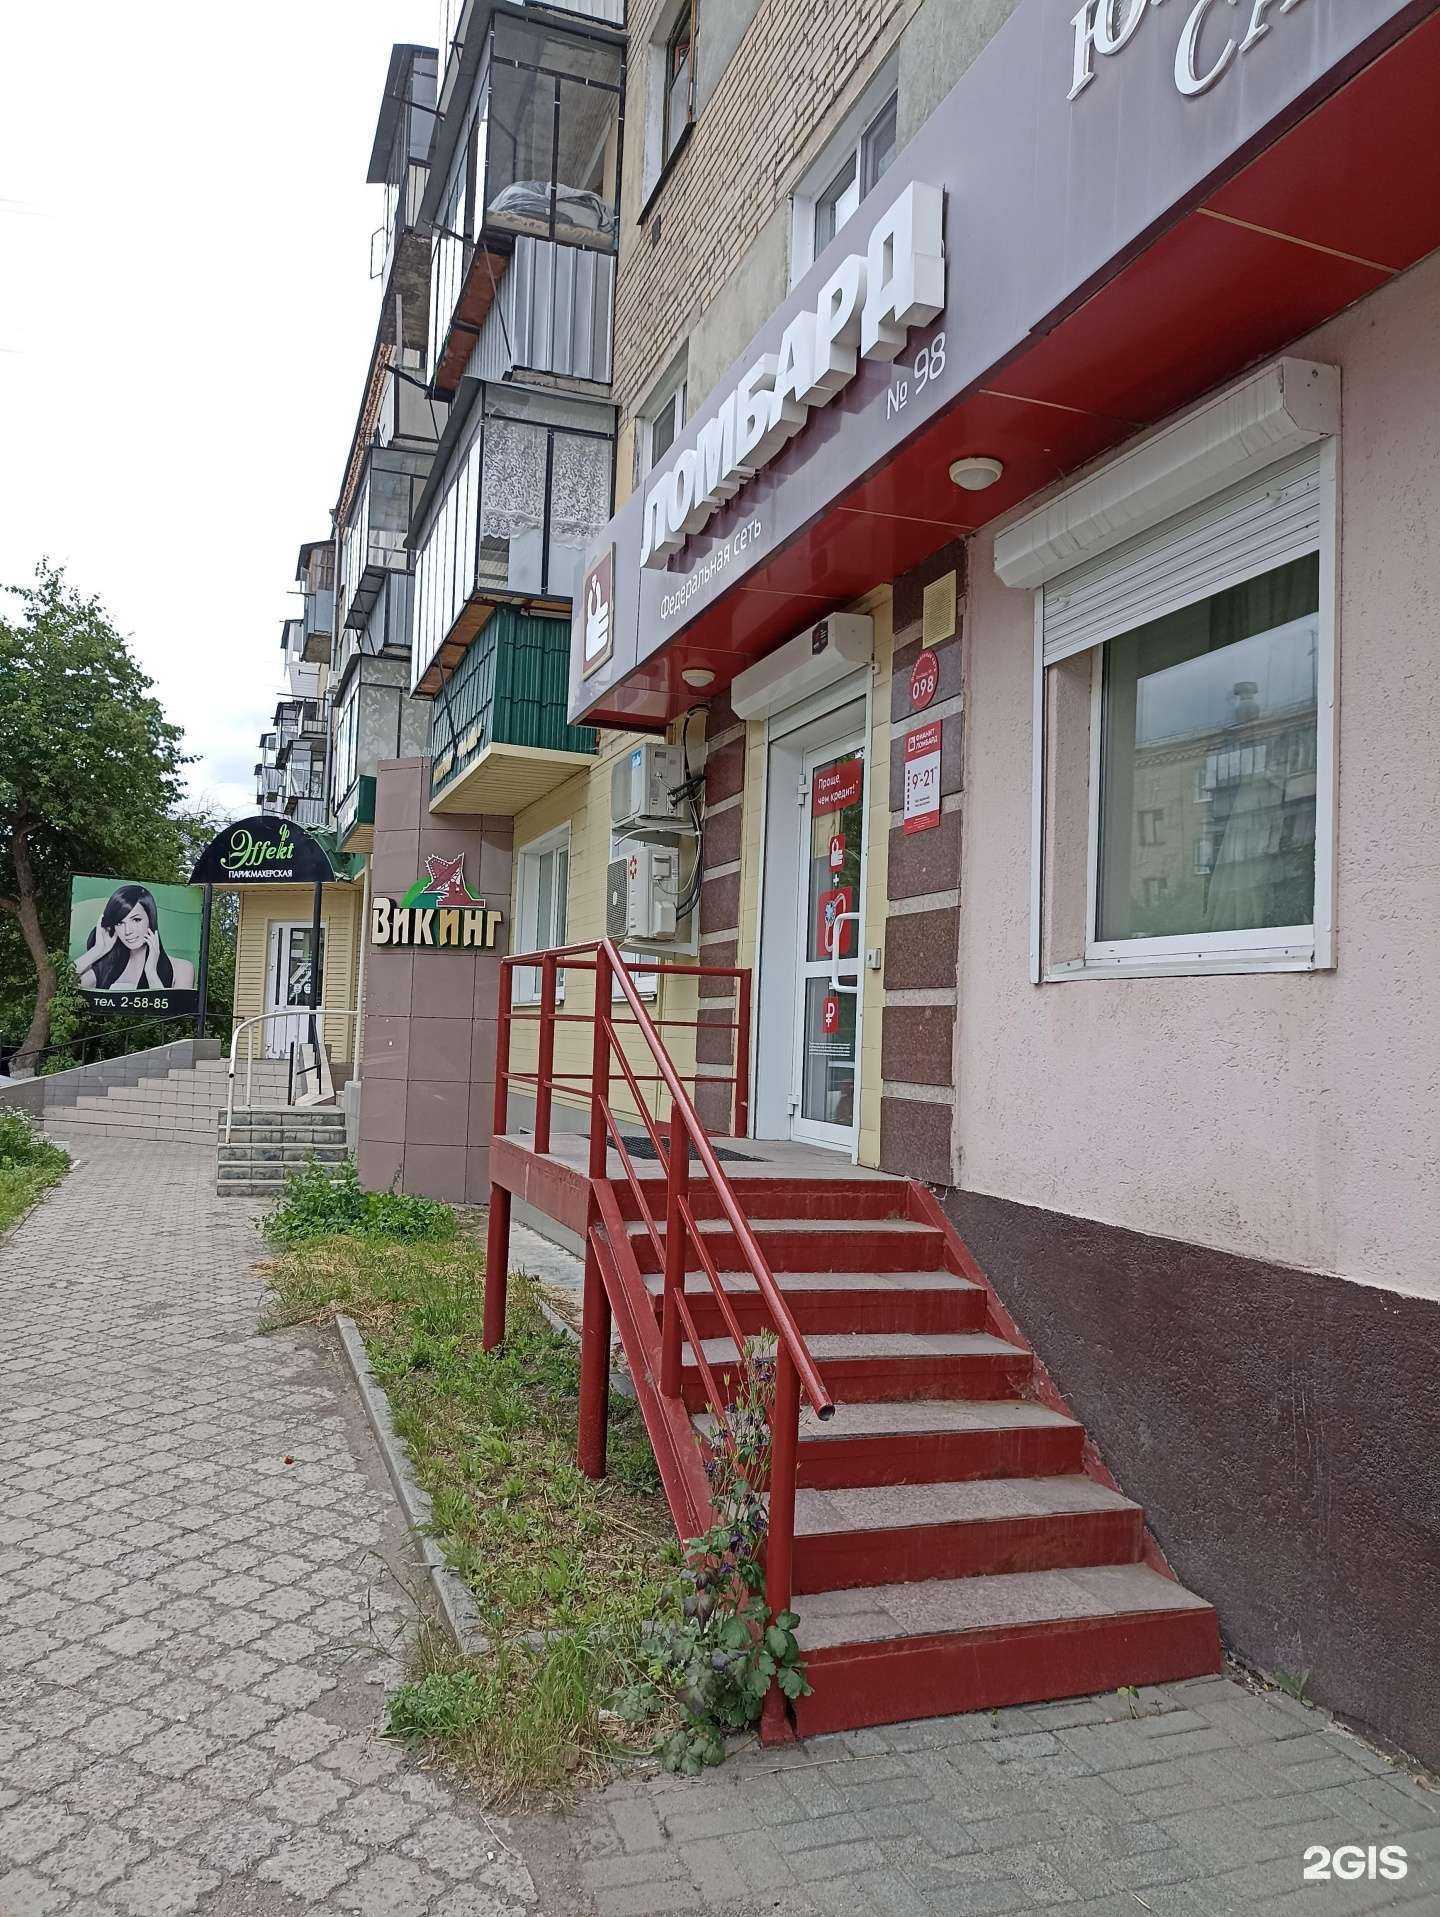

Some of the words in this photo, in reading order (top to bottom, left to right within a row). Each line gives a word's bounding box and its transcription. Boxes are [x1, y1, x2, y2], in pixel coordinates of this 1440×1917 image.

[640, 180, 945, 568] ЛОМБАРД
[887, 381, 908, 420] №
[914, 332, 946, 395] 98
[660, 544, 730, 619] Федеральная
[733, 519, 762, 556] сеть
[912, 675, 934, 700] 098
[818, 774, 840, 790] Проще
[228, 869, 293, 879] ПАРИКМАХЕРСКАЯ
[120, 996, 169, 1009] 2-58-85
